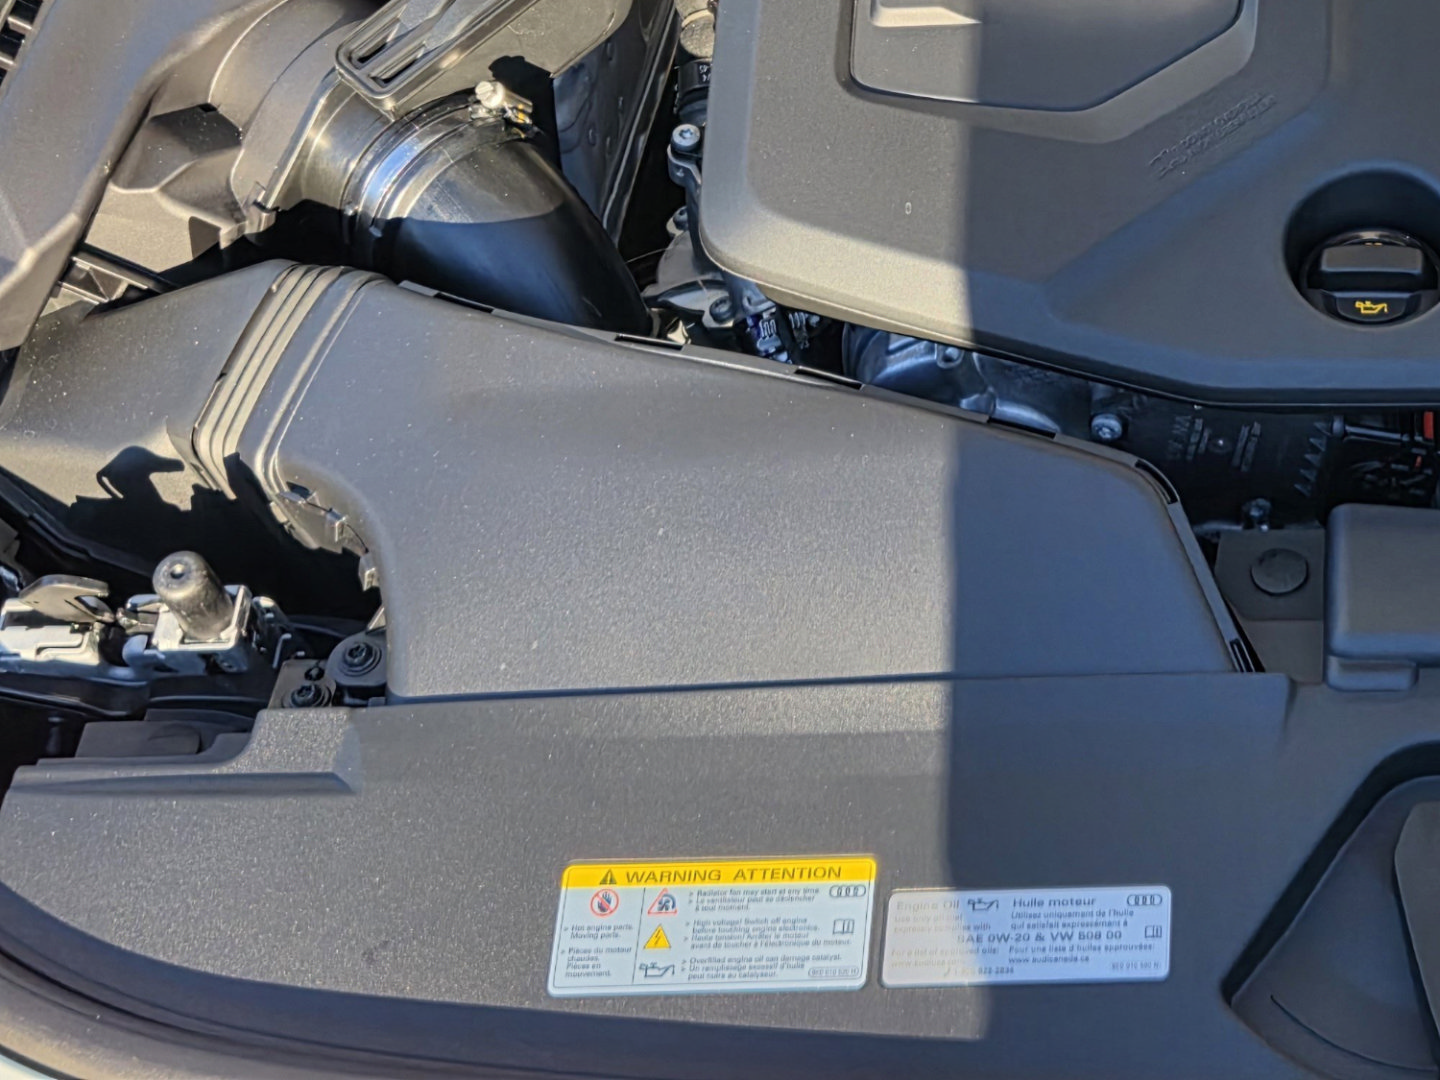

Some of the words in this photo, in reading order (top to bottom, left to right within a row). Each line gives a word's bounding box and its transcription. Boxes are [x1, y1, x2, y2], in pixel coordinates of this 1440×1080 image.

[626, 868, 722, 884] WARNING
[733, 865, 842, 881] ATTENTION
[696, 889, 727, 897] Radiator
[743, 889, 759, 897] may
[760, 888, 777, 896] start
[706, 895, 746, 904] ventilateur
[747, 895, 763, 905] peut
[1012, 897, 1045, 908] Huile
[1048, 897, 1096, 907] moteur
[896, 901, 939, 912] Engine
[943, 899, 960, 909] Oil
[1011, 910, 1042, 920] Utilisez
[1043, 909, 1094, 919] uniquement
[1095, 909, 1106, 918] de
[693, 919, 711, 929] High
[782, 917, 808, 926] engine
[973, 923, 991, 931] with
[1010, 920, 1025, 930] qui
[1026, 920, 1060, 929] satisfait
[587, 924, 612, 933] engine
[692, 926, 716, 934] before
[718, 926, 750, 935] touching
[752, 925, 777, 934] engine
[570, 932, 599, 940] Moving
[691, 933, 714, 941] Haute
[957, 932, 984, 944] SAE
[987, 931, 1031, 943] 0W-20
[1035, 932, 1045, 942] &
[1050, 931, 1073, 942] VW
[1106, 930, 1122, 940] 00
[690, 941, 711, 950] avant
[724, 940, 752, 948] toucher
[811, 938, 821, 946] du
[1009, 944, 1029, 954] Pour
[1031, 945, 1047, 953] une
[1048, 943, 1067, 953] liste
[689, 957, 726, 965] Overfilled
[727, 956, 753, 965] engine
[779, 955, 810, 963] damage
[687, 972, 705, 981] peut
[727, 971, 737, 979] au
